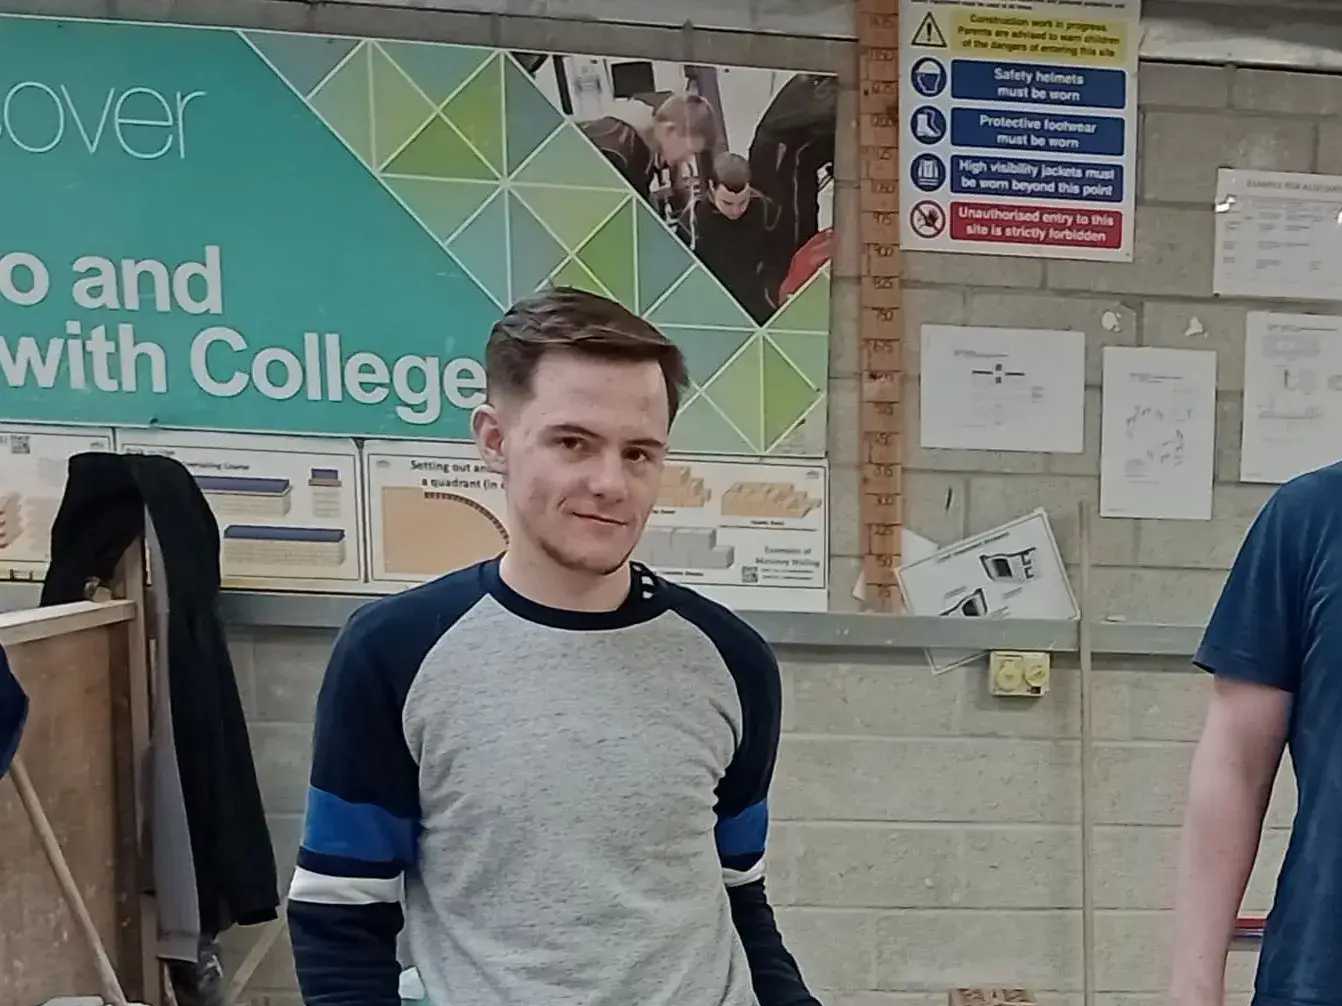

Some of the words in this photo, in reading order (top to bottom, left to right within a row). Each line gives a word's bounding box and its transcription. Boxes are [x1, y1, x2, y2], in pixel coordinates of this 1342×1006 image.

[970, 14, 1029, 27] Construction
[1032, 18, 1052, 28] work
[1056, 20, 1064, 29] in
[958, 26, 992, 37] Parents
[995, 30, 1009, 38] are
[1011, 29, 1046, 40] advised
[1049, 32, 1058, 41] to
[1084, 34, 1120, 45] children
[961, 38, 972, 48] of
[974, 39, 988, 48] the
[991, 40, 1028, 53] dangers
[1031, 43, 1040, 52] of
[1080, 47, 1096, 56] this
[994, 68, 1033, 85] Safety
[1036, 72, 1084, 85] helmets
[997, 86, 1028, 98] must
[1031, 87, 1046, 98] be
[1049, 91, 1081, 101] worn
[0, 81, 207, 159] over
[980, 114, 1041, 130] Protective
[1044, 119, 1097, 134] footwear
[997, 133, 1028, 145] must
[1030, 134, 1046, 146] be
[1048, 138, 1080, 148] worn
[959, 160, 988, 174] High
[991, 162, 1039, 178] visibility
[1041, 165, 1083, 179] jackets
[1085, 169, 1115, 180] must
[961, 177, 976, 188] be
[979, 179, 1009, 190] worn
[1012, 179, 1056, 193] beyond
[1058, 181, 1080, 194] this
[1083, 184, 1113, 197] point
[958, 206, 1040, 222] Unauthorised
[1042, 212, 1074, 227] entry
[1076, 214, 1090, 225] to
[1091, 214, 1115, 226] this
[966, 224, 988, 235] site
[991, 225, 1002, 235] is
[1005, 226, 1046, 241] strictly
[1048, 228, 1107, 242] forbidden
[72, 245, 223, 314] and
[0, 320, 167, 394] with
[190, 326, 487, 424] College
[410, 460, 450, 473] Setting
[452, 463, 471, 473] out
[473, 464, 488, 473] an
[421, 478, 429, 487] a
[431, 478, 480, 490] quadrant
